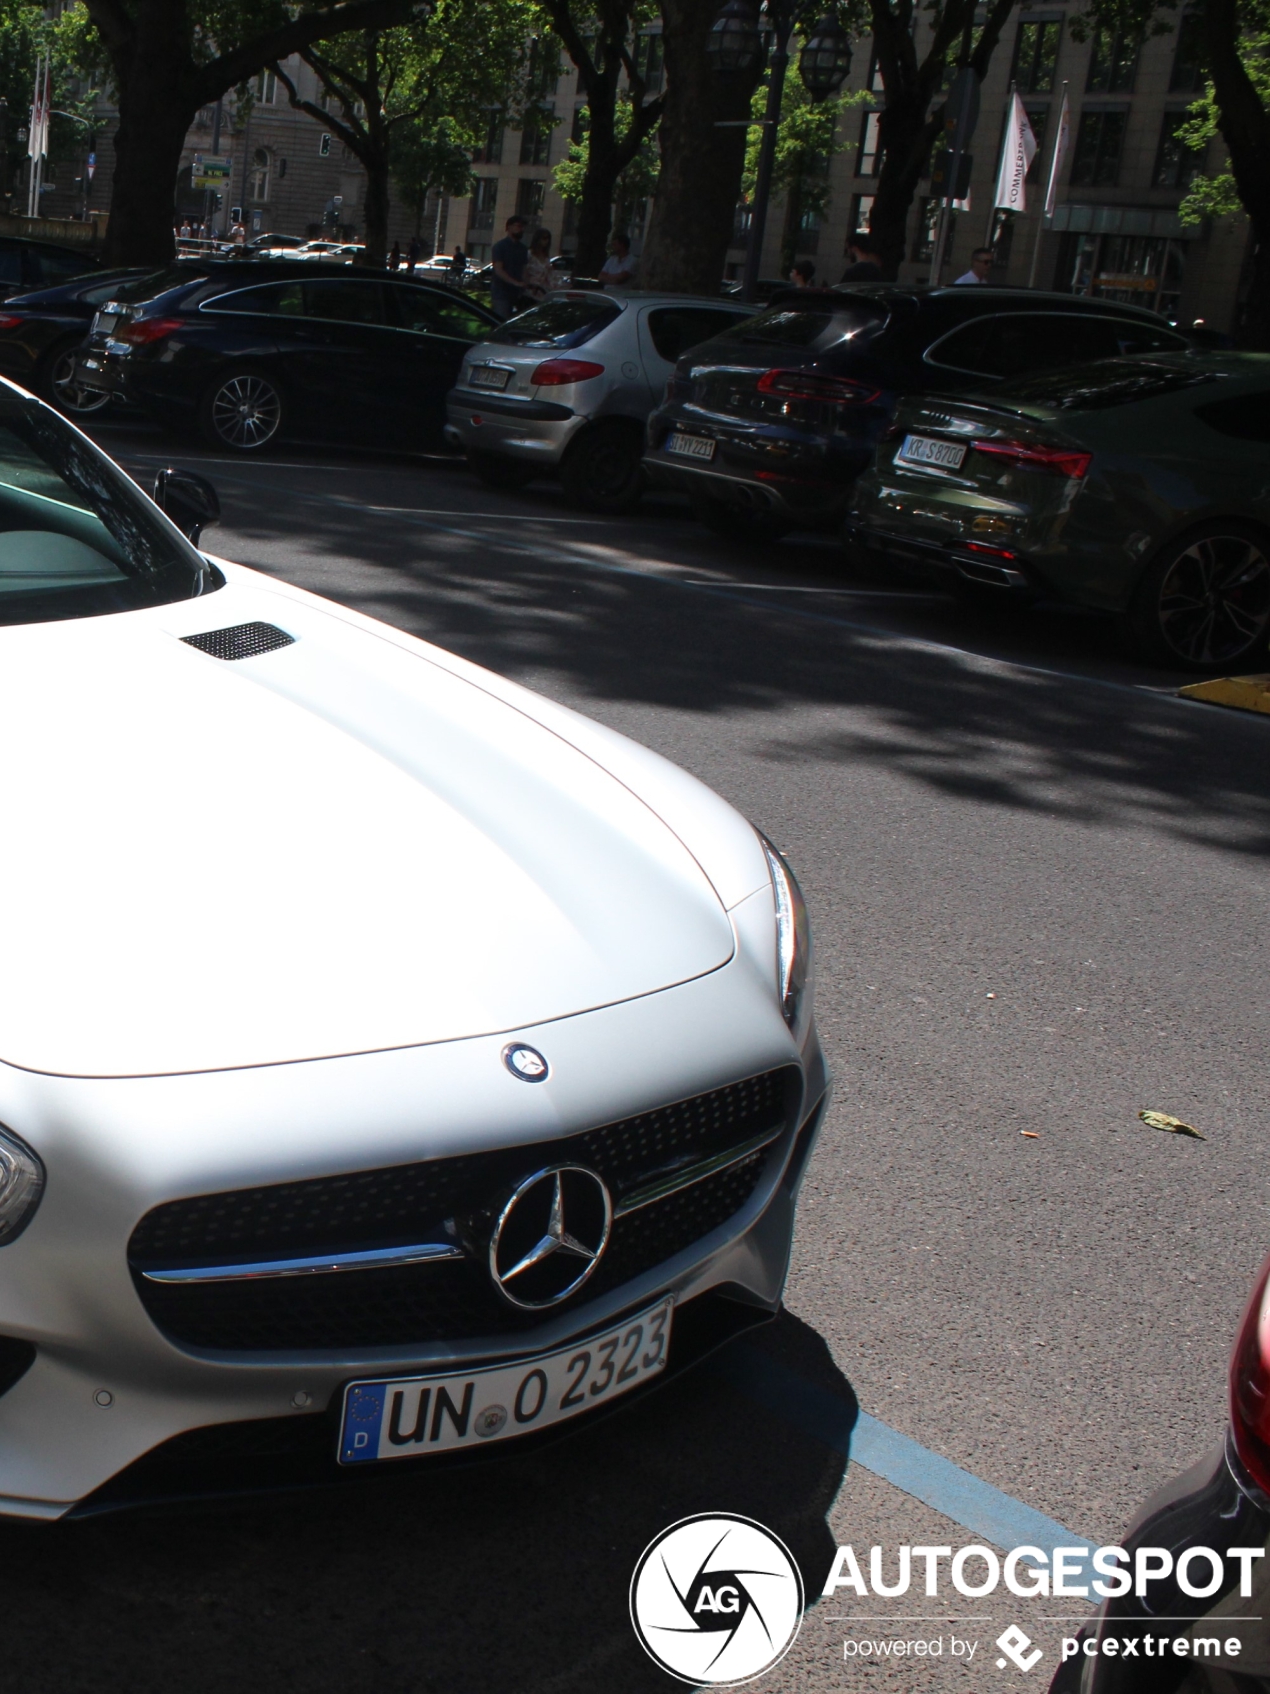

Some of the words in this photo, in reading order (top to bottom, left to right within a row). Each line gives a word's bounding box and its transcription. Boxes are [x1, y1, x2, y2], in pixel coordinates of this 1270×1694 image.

[692, 440, 714, 457] 2211
[907, 438, 924, 457] KR
[926, 442, 937, 459] S
[934, 444, 964, 466] 8700
[353, 1431, 369, 1449] D
[388, 1381, 476, 1446] UN
[559, 1308, 668, 1411] 2323
